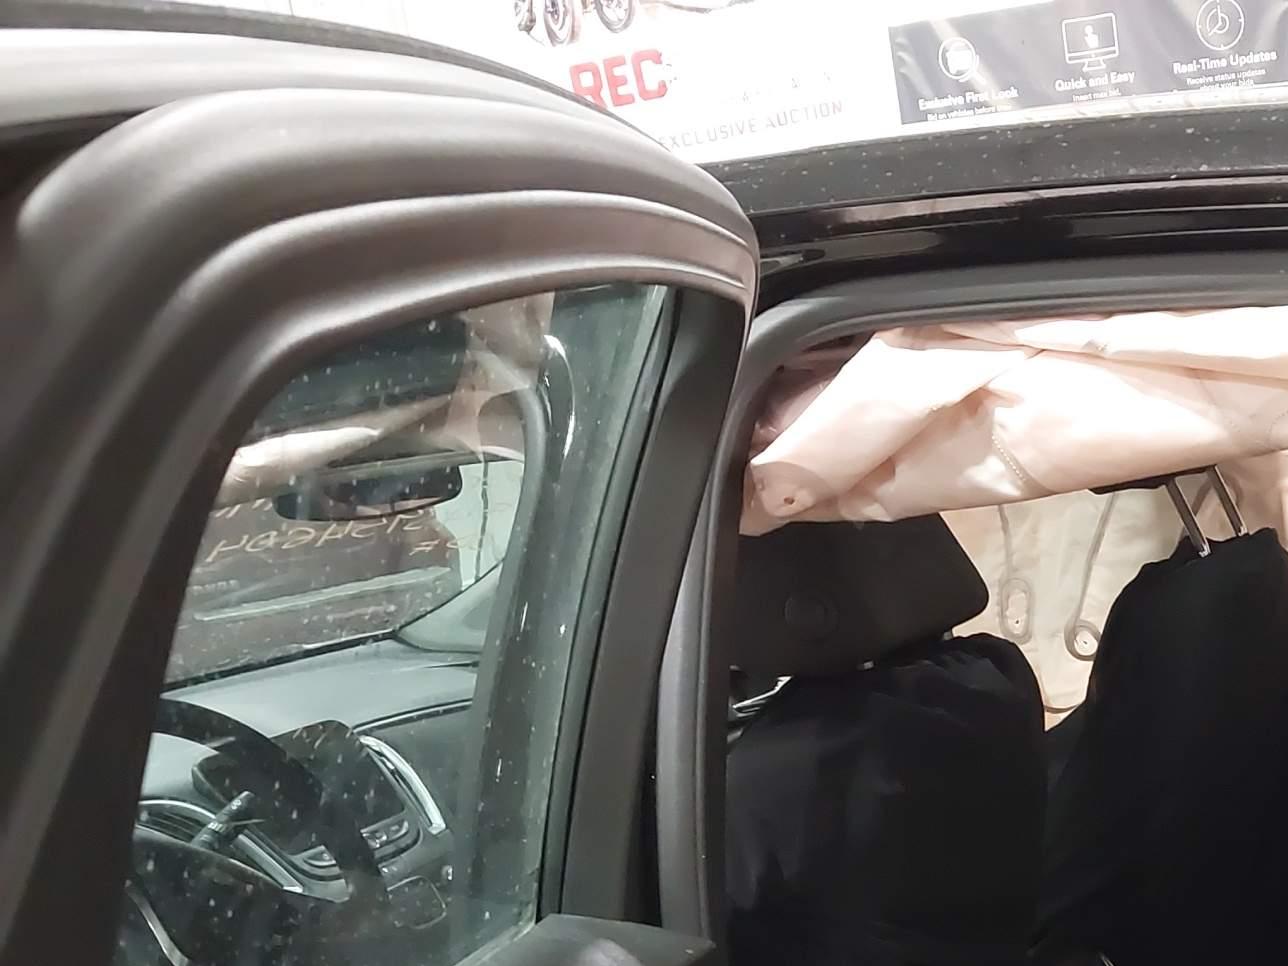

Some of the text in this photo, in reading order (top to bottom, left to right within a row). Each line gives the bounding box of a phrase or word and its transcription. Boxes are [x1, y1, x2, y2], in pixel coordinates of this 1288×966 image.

[1173, 50, 1278, 75] Real-Time Updates
[1054, 71, 1136, 92] Quick and Easy
[1237, 68, 1267, 79] updates
[991, 86, 1019, 100] Look
[765, 100, 844, 129] AUCTION
